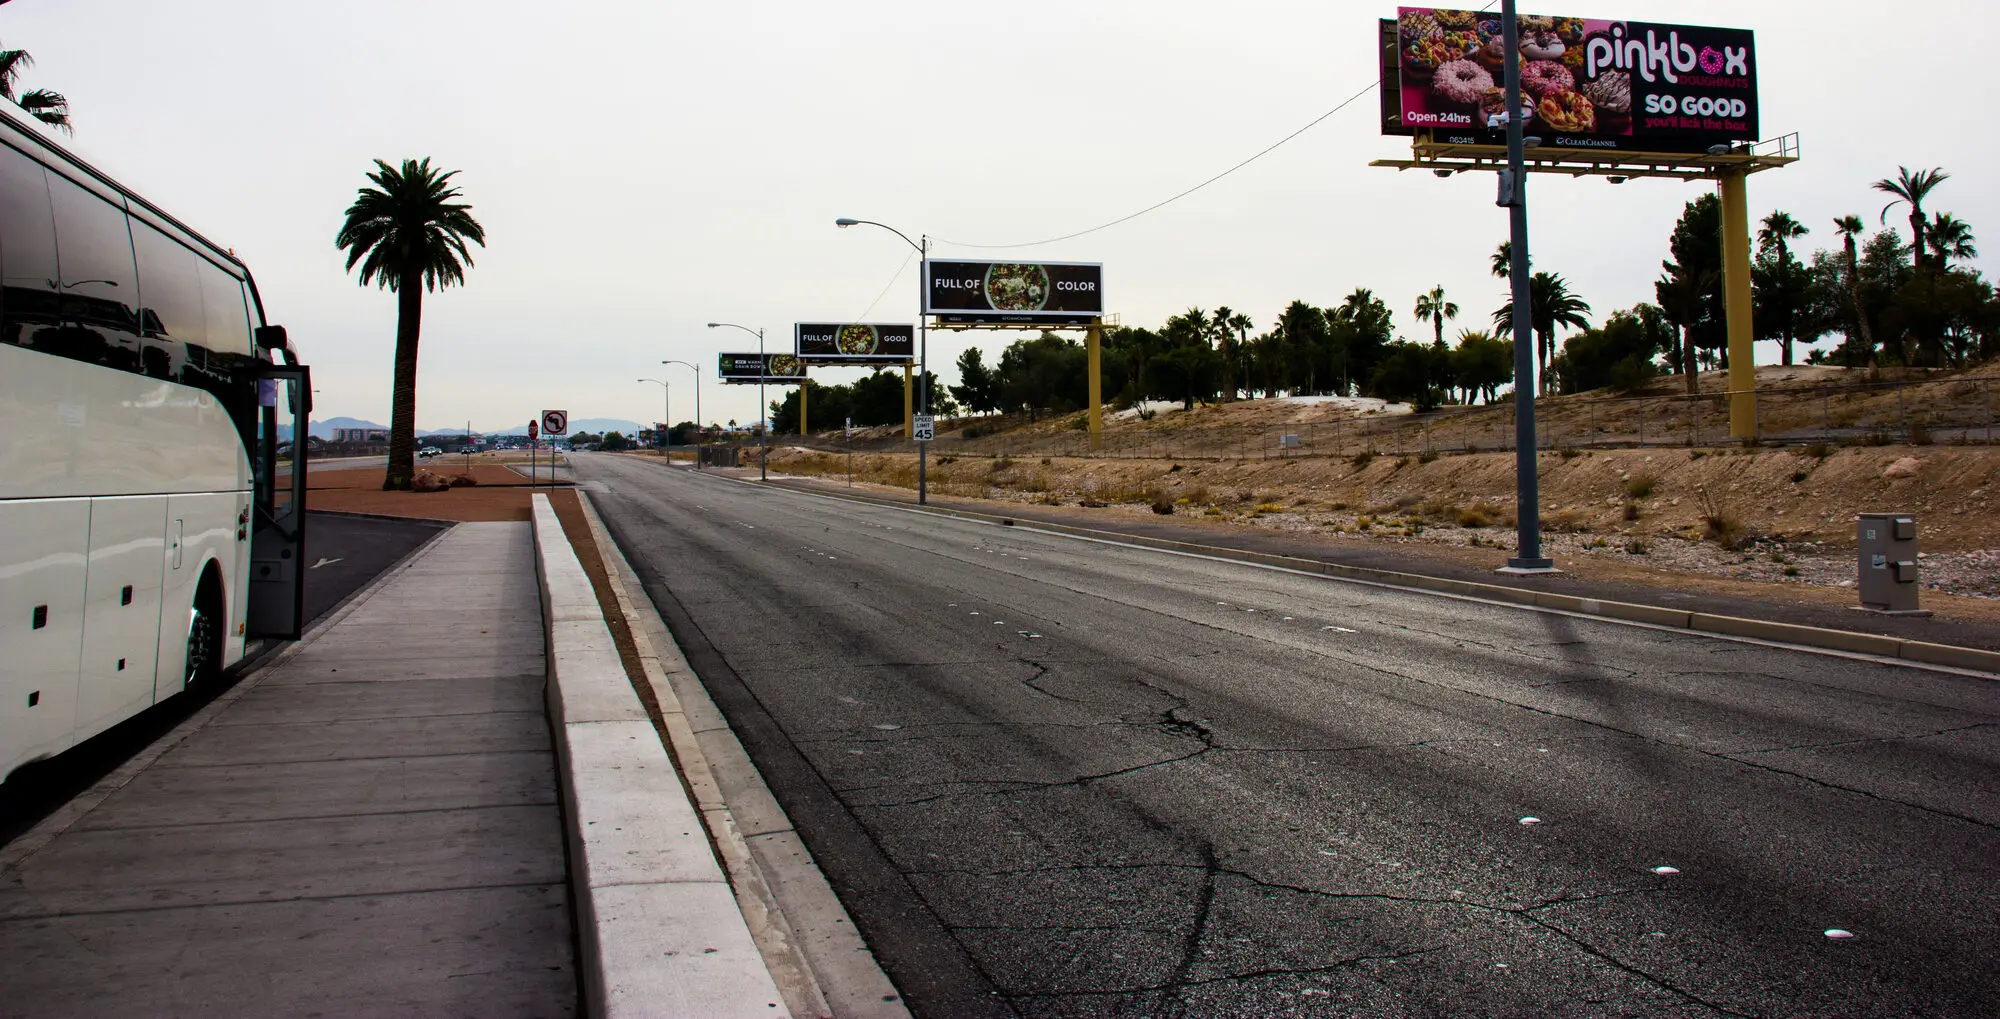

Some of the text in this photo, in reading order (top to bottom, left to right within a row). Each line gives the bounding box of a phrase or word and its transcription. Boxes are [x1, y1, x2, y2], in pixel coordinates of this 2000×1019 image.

[1587, 27, 1747, 83] pinkbox
[1680, 75, 1749, 88] DOUGHNUTS
[1645, 94, 1747, 117] SO GOOD
[1407, 111, 1471, 123] Open 24hrs
[1645, 117, 1677, 129] you'll
[1680, 117, 1700, 128] lick
[1703, 118, 1722, 130] the
[935, 278, 1095, 291] FULL OF COLOR
[914, 429, 932, 439] 45
